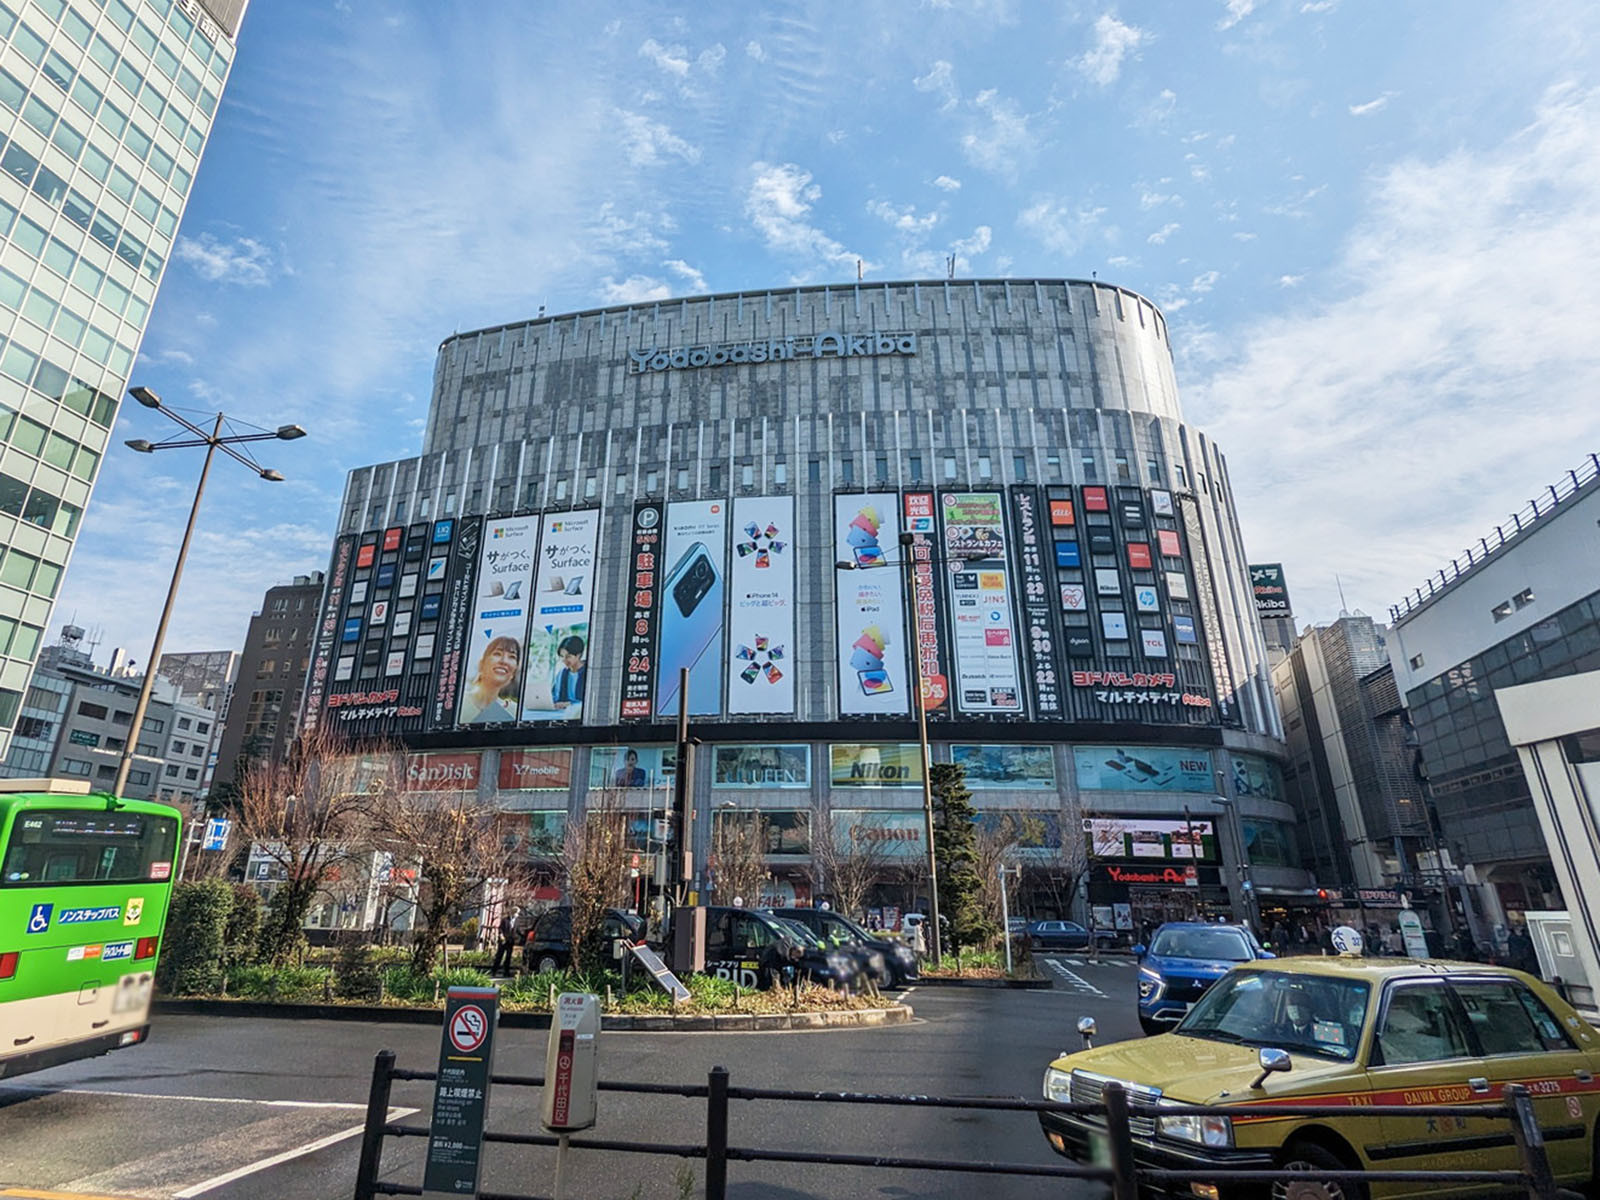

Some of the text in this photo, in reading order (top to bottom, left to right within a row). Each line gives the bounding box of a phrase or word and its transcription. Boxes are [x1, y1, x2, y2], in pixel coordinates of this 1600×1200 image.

[631, 330, 917, 373] Yodobashi-Akiba
[492, 562, 530, 575] Surface
[551, 557, 591, 569] Surface
[634, 552, 655, 608] 駐車場
[635, 619, 649, 636] 8
[628, 657, 650, 673] 24
[1073, 672, 1175, 687] ヨドバシカメラ
[328, 689, 399, 707] ヨドバシカメラ
[1096, 691, 1180, 704] マルチメディア
[340, 706, 398, 720] マルチメディア
[408, 763, 474, 782] SanDisk
[851, 762, 910, 780] Nikon
[1180, 760, 1208, 772] NEW
[59, 907, 120, 924] ノンステップバス
[555, 1072, 569, 1122] 千代田区
[1347, 1096, 1374, 1107] TAXI
[1403, 1087, 1471, 1105] DAIWA GROUP
